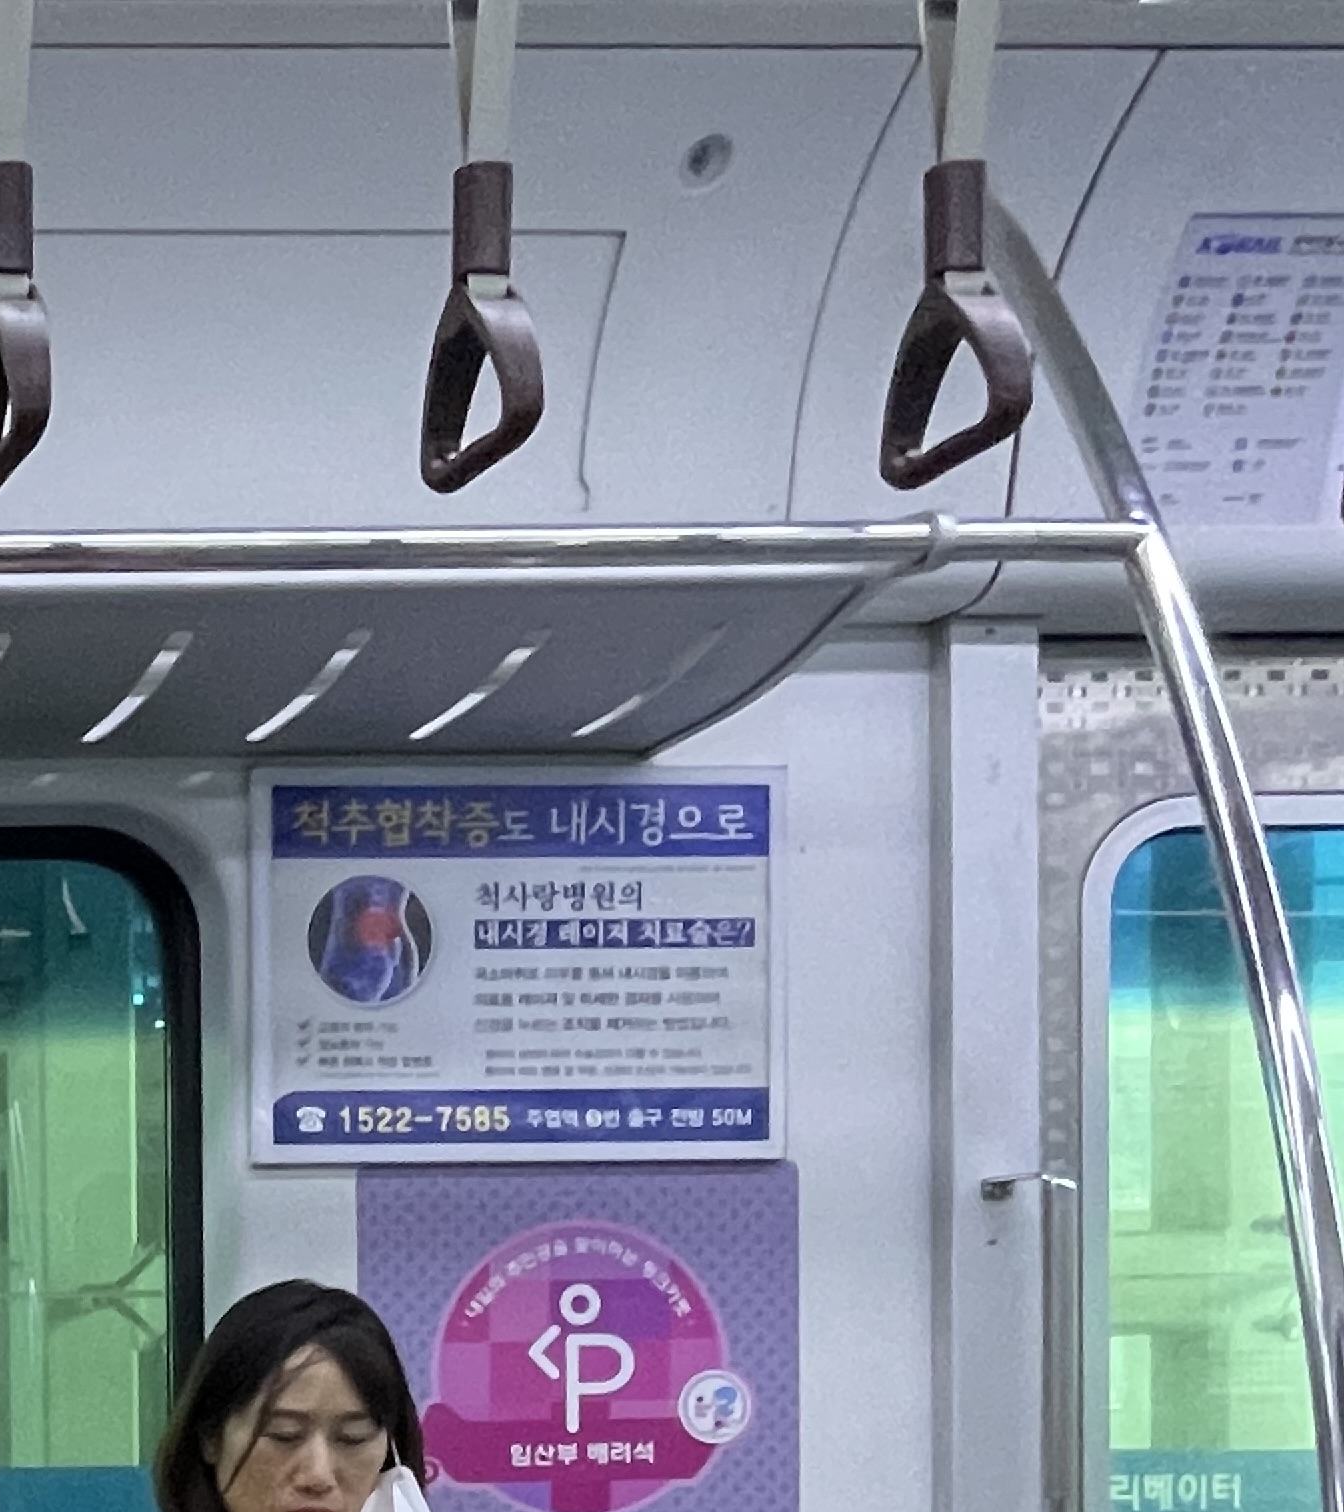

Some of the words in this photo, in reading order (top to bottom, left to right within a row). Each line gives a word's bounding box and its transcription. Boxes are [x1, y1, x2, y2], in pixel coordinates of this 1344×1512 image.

[292, 799, 534, 848] 척추협착증도
[550, 799, 754, 846] 내시경으로
[477, 919, 548, 946] 내시경
[338, 1105, 511, 1133] 1522-7585
[712, 1108, 753, 1127] 50M
[510, 1442, 579, 1467] 임산부
[587, 1440, 655, 1465] 배려석
[1109, 1472, 1242, 1512] 리베이터
